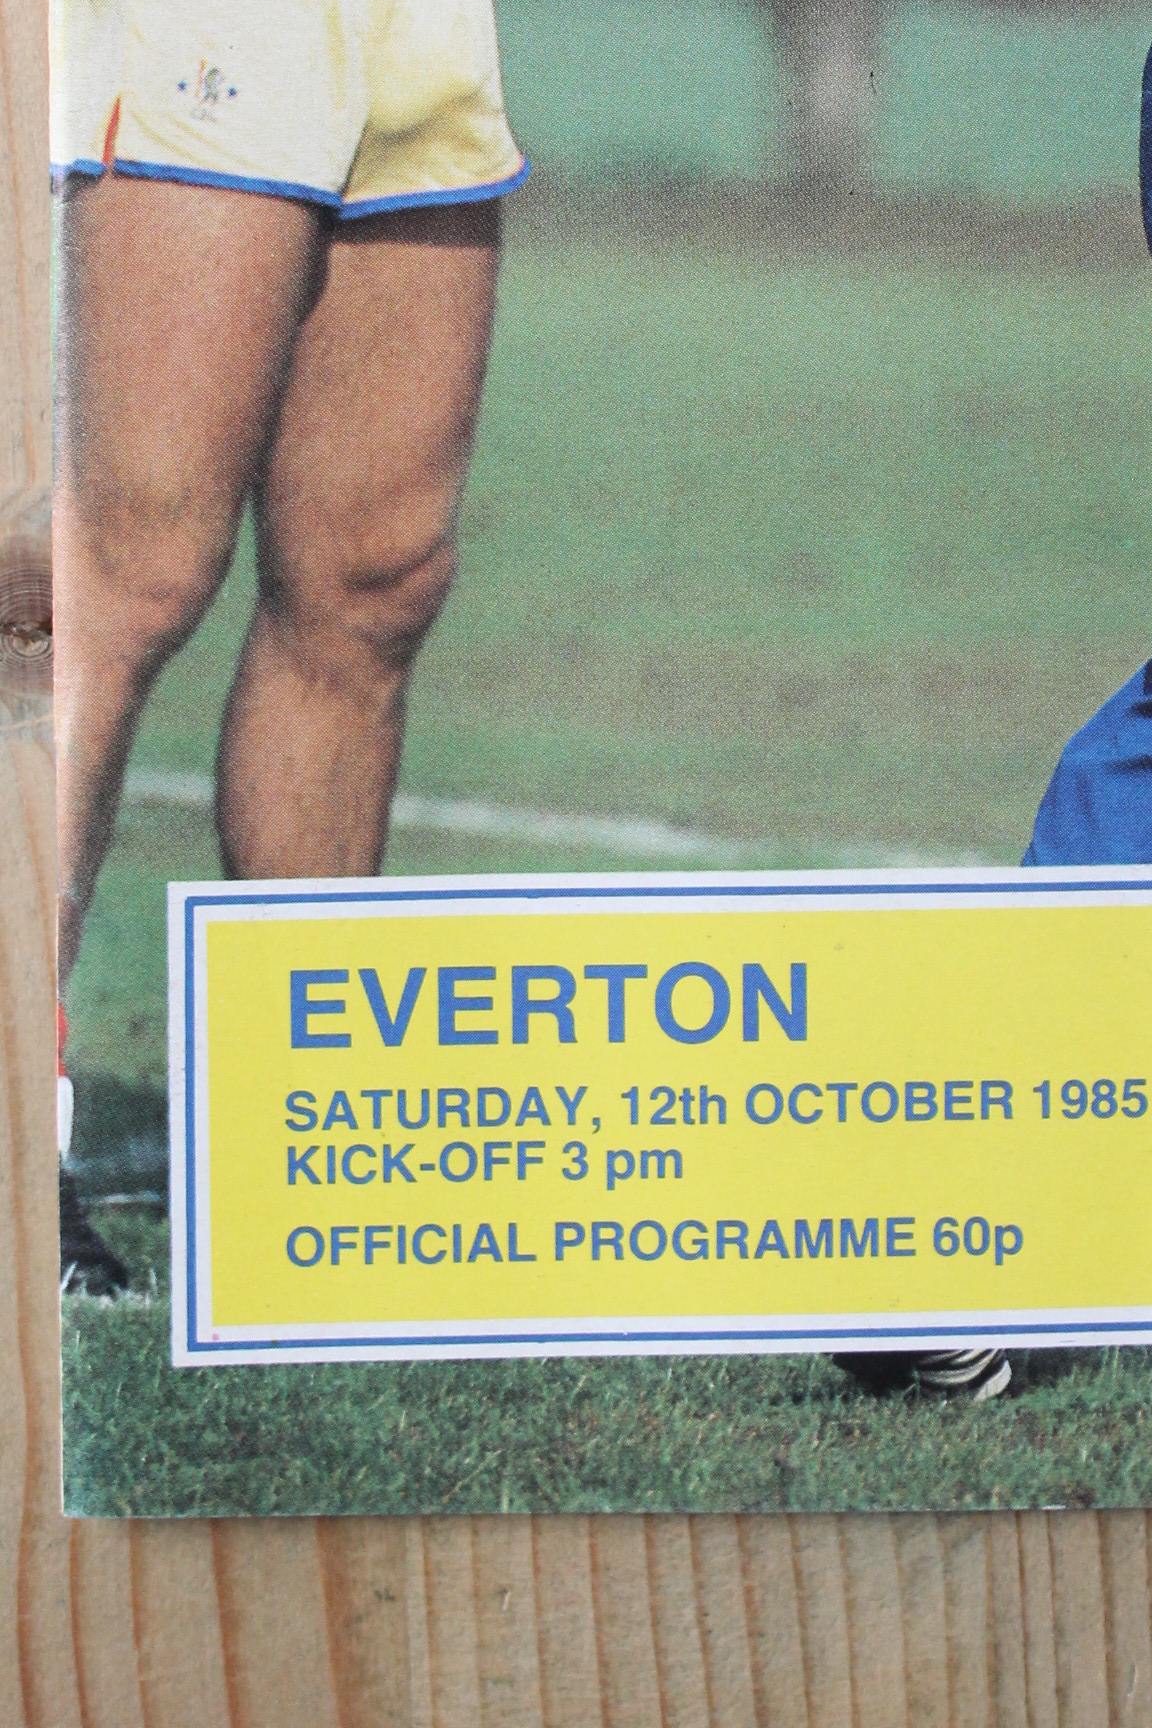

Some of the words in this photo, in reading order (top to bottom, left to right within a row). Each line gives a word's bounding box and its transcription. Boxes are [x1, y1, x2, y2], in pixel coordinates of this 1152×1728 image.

[290, 962, 807, 1049] EVERTON
[285, 1085, 601, 1134] SATURDAY,
[621, 1085, 727, 1125] 12th
[746, 1081, 1012, 1124] OCTOBER
[1033, 1078, 1148, 1119] 1985
[287, 1141, 543, 1184] KICK-OFF
[561, 1141, 589, 1181] 3
[606, 1150, 682, 1190] pm
[287, 1224, 534, 1267] OFFICIAL
[555, 1218, 914, 1261] PROGRAMME
[933, 1218, 1023, 1265] 60p
